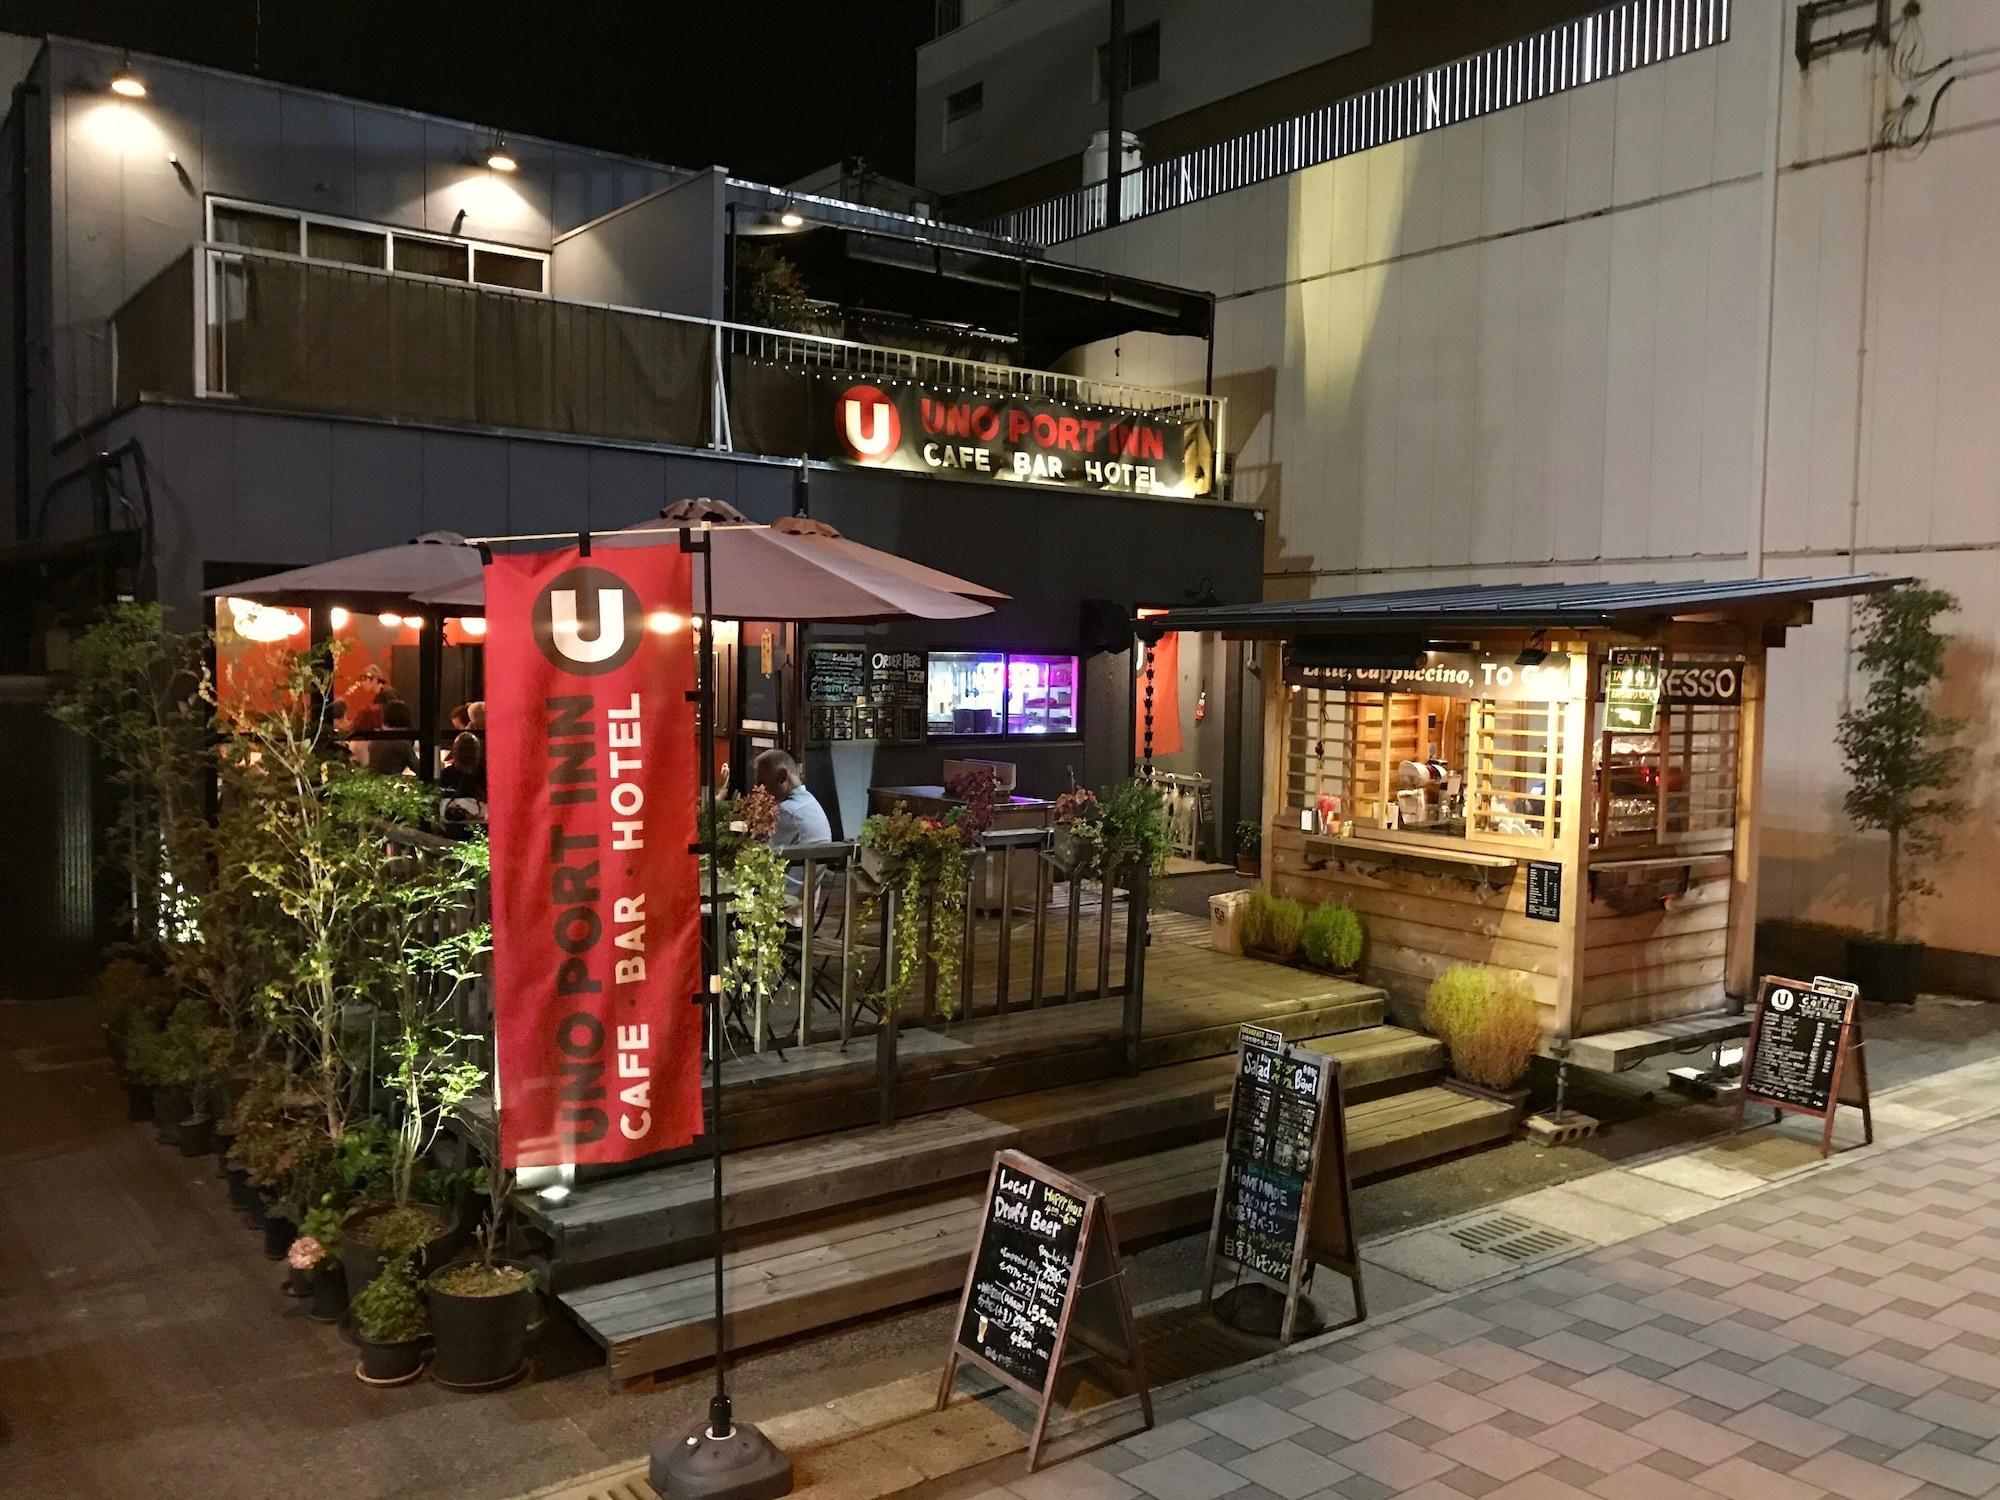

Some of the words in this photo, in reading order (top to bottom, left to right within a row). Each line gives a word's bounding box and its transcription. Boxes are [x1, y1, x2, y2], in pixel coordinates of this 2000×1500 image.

[845, 400, 890, 455] U
[920, 398, 1000, 442] UNO
[1008, 409, 1101, 454] PORT
[1109, 422, 1165, 461] INN
[923, 442, 991, 473] CAFE
[1013, 450, 1064, 480] BAR
[1086, 461, 1165, 489] HOTEL
[550, 588, 625, 663] U
[1617, 653, 1637, 665] EAT
[1640, 653, 1652, 666] IN
[547, 694, 595, 802] INN
[607, 692, 645, 851] HOTEL
[550, 826, 602, 997] PORT
[613, 892, 647, 986] BAR
[1777, 993, 1788, 1005] U
[556, 1012, 610, 1147] UNO
[618, 1022, 652, 1141] CAFE
[1244, 1052, 1271, 1079] Salad
[1295, 1068, 1317, 1095] Bagel
[1000, 1168, 1036, 1200] Local
[994, 1195, 1028, 1224] Draft
[1030, 1209, 1062, 1238] Beer
